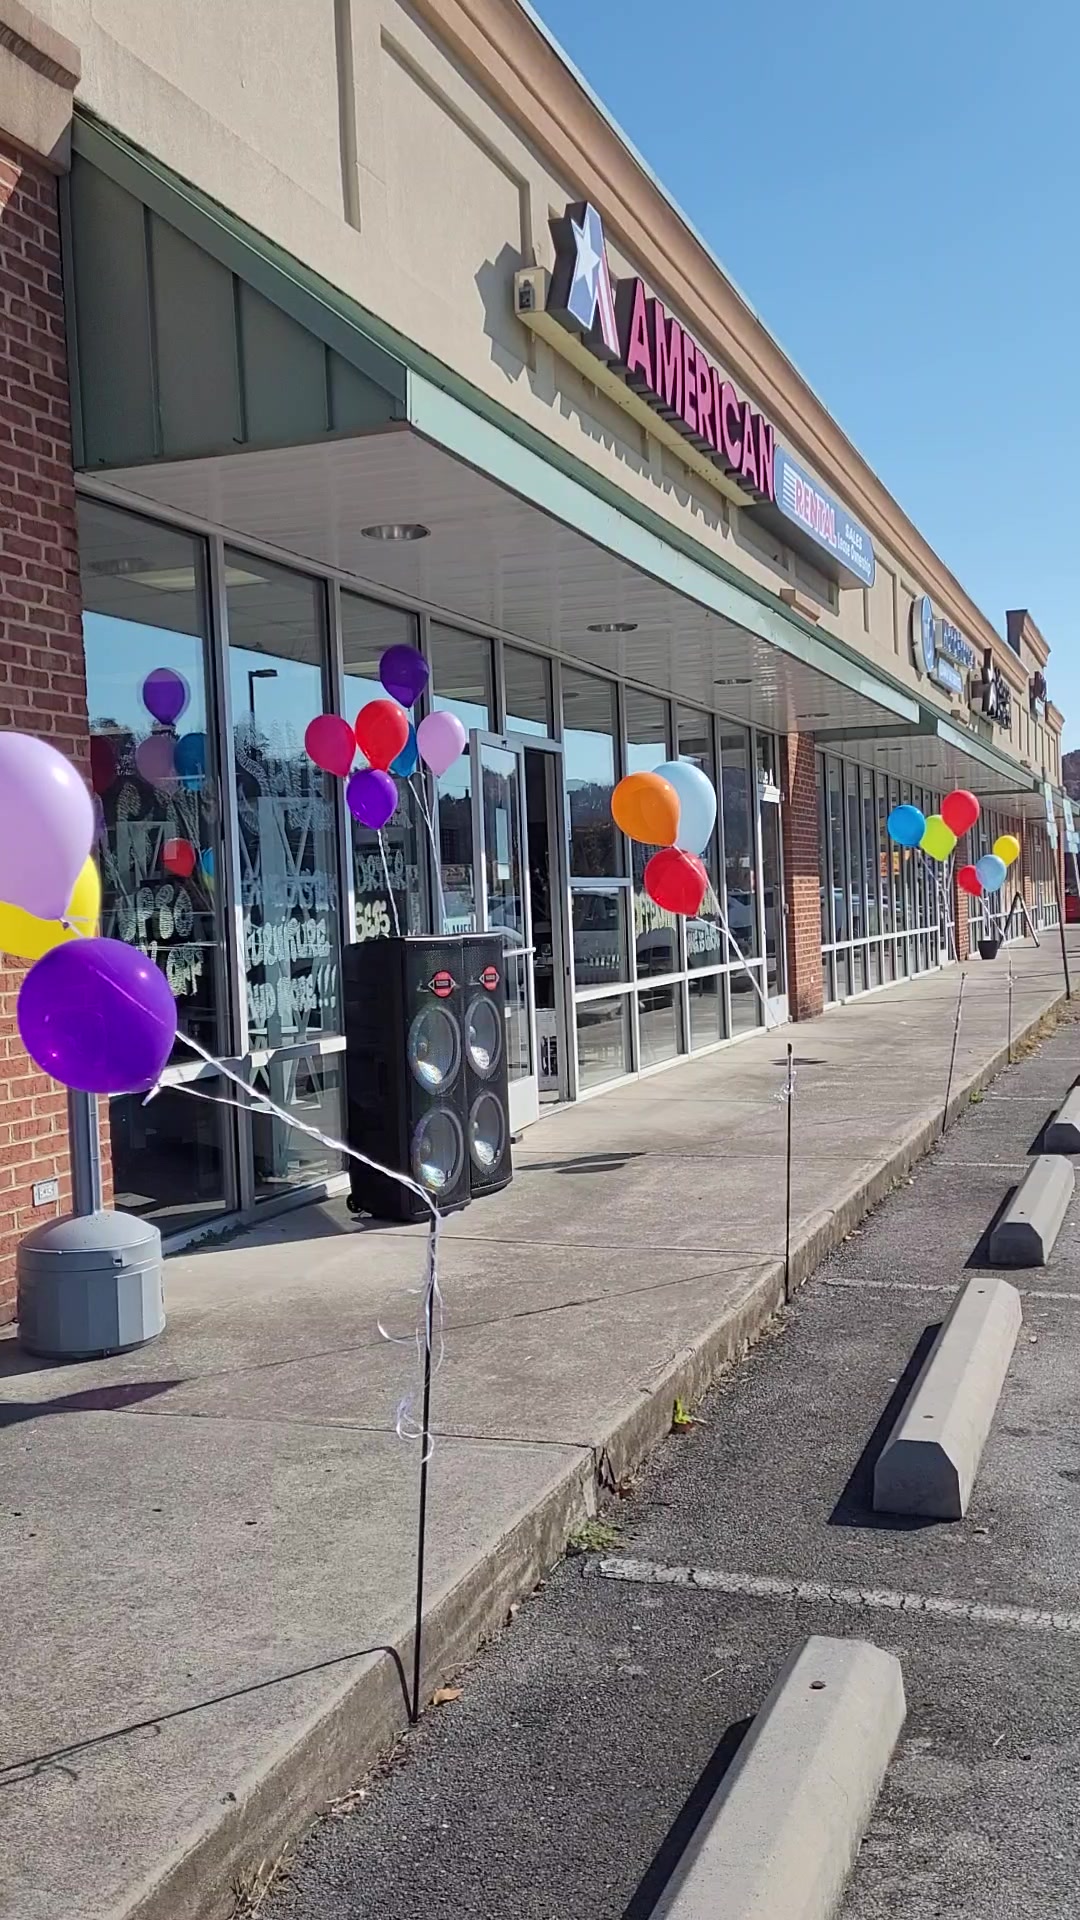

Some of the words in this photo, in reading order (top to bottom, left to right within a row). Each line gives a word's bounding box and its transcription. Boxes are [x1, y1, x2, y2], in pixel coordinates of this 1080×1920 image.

[627, 278, 775, 502] AMERICAN
[794, 479, 838, 549] RENTAL
[244, 913, 331, 973] FURNITURE
